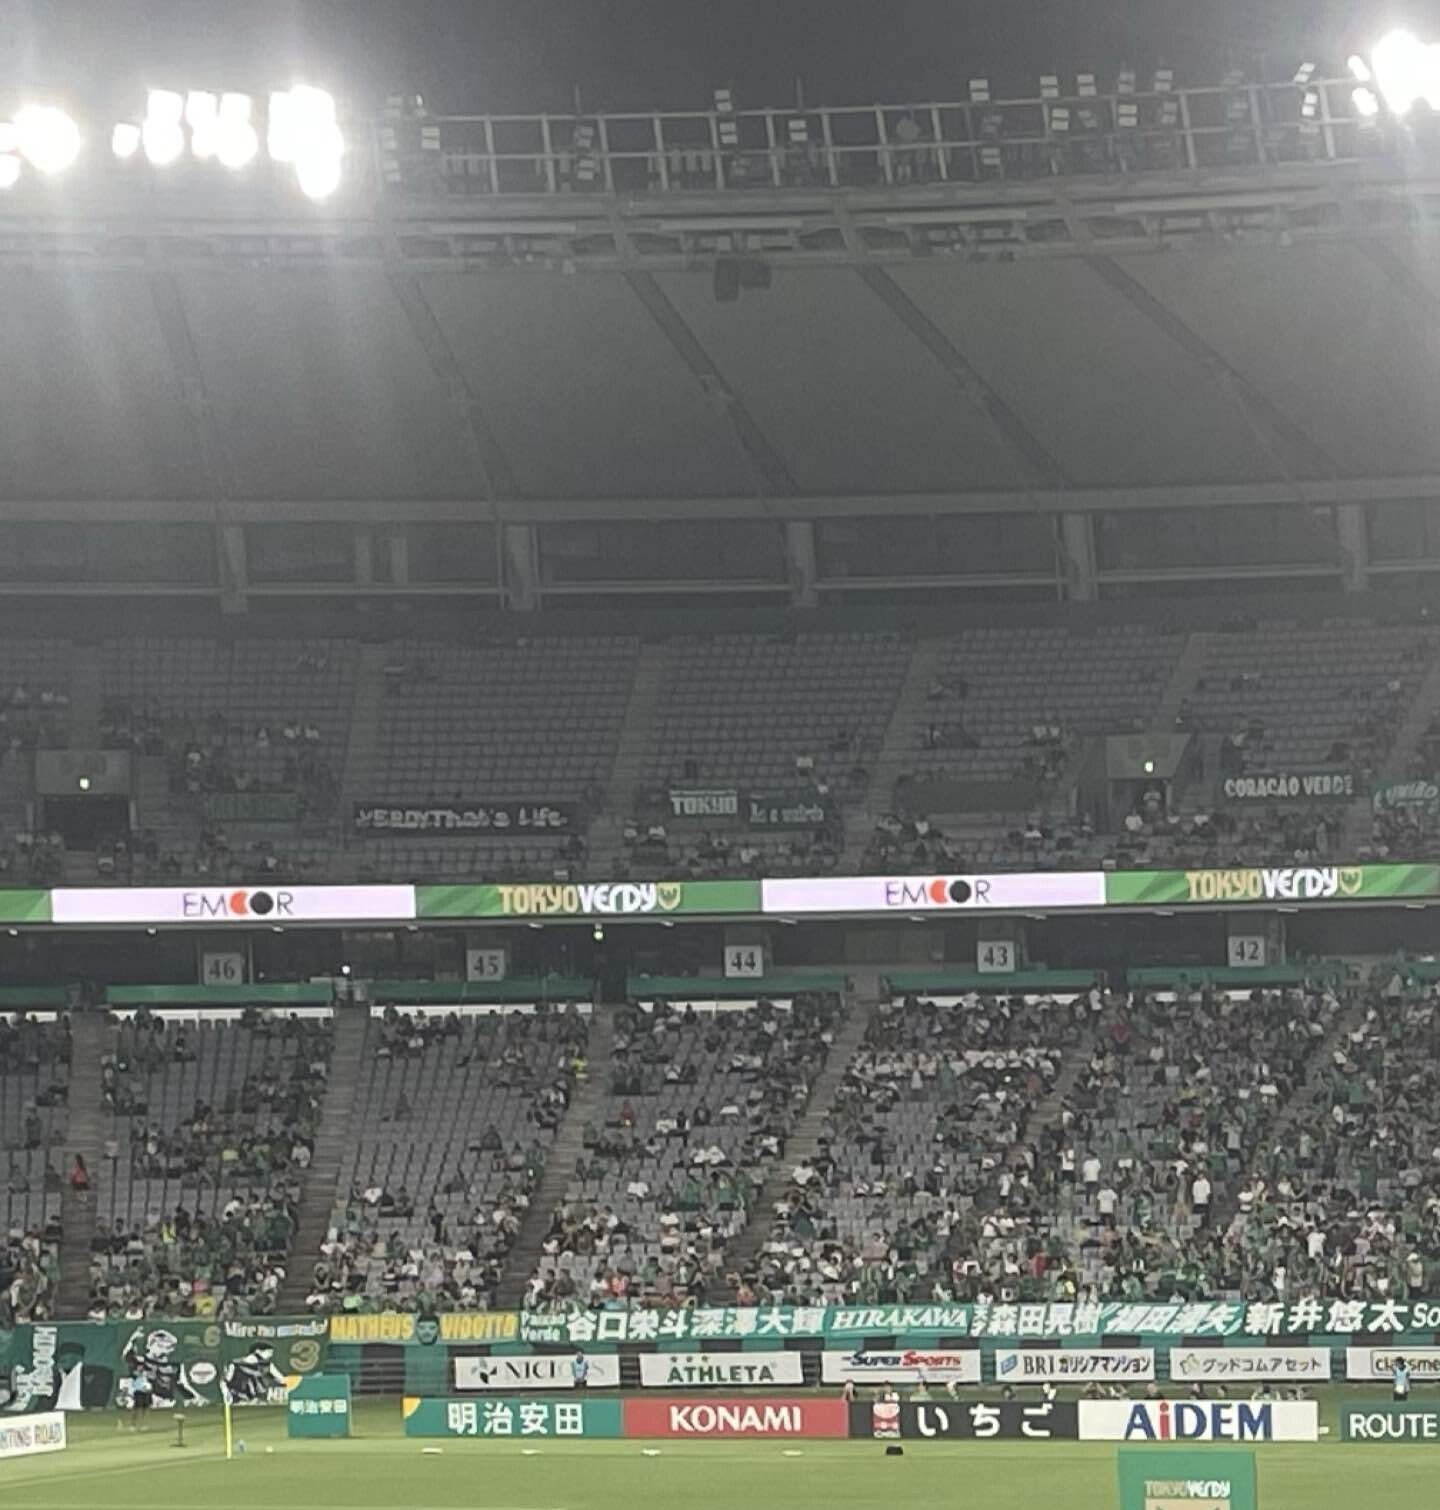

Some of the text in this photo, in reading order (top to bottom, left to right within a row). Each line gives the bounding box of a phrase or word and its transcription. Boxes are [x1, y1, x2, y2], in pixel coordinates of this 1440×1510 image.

[730, 950, 758, 972] 44
[983, 945, 1009, 967] 43
[1234, 940, 1260, 962] 42
[209, 958, 236, 981] 46
[473, 954, 500, 976] 45
[831, 1308, 968, 1330] HIRAKAWA
[1244, 1300, 1408, 1334] 新井悠太
[667, 1364, 774, 1382] ATHLETA
[1202, 1355, 1322, 1373] グッドコムアセット
[447, 1401, 584, 1435] 明治安田
[670, 1405, 802, 1432] KONAMI
[918, 1402, 1054, 1437] いちご
[1349, 1412, 1440, 1440] ROUTE
